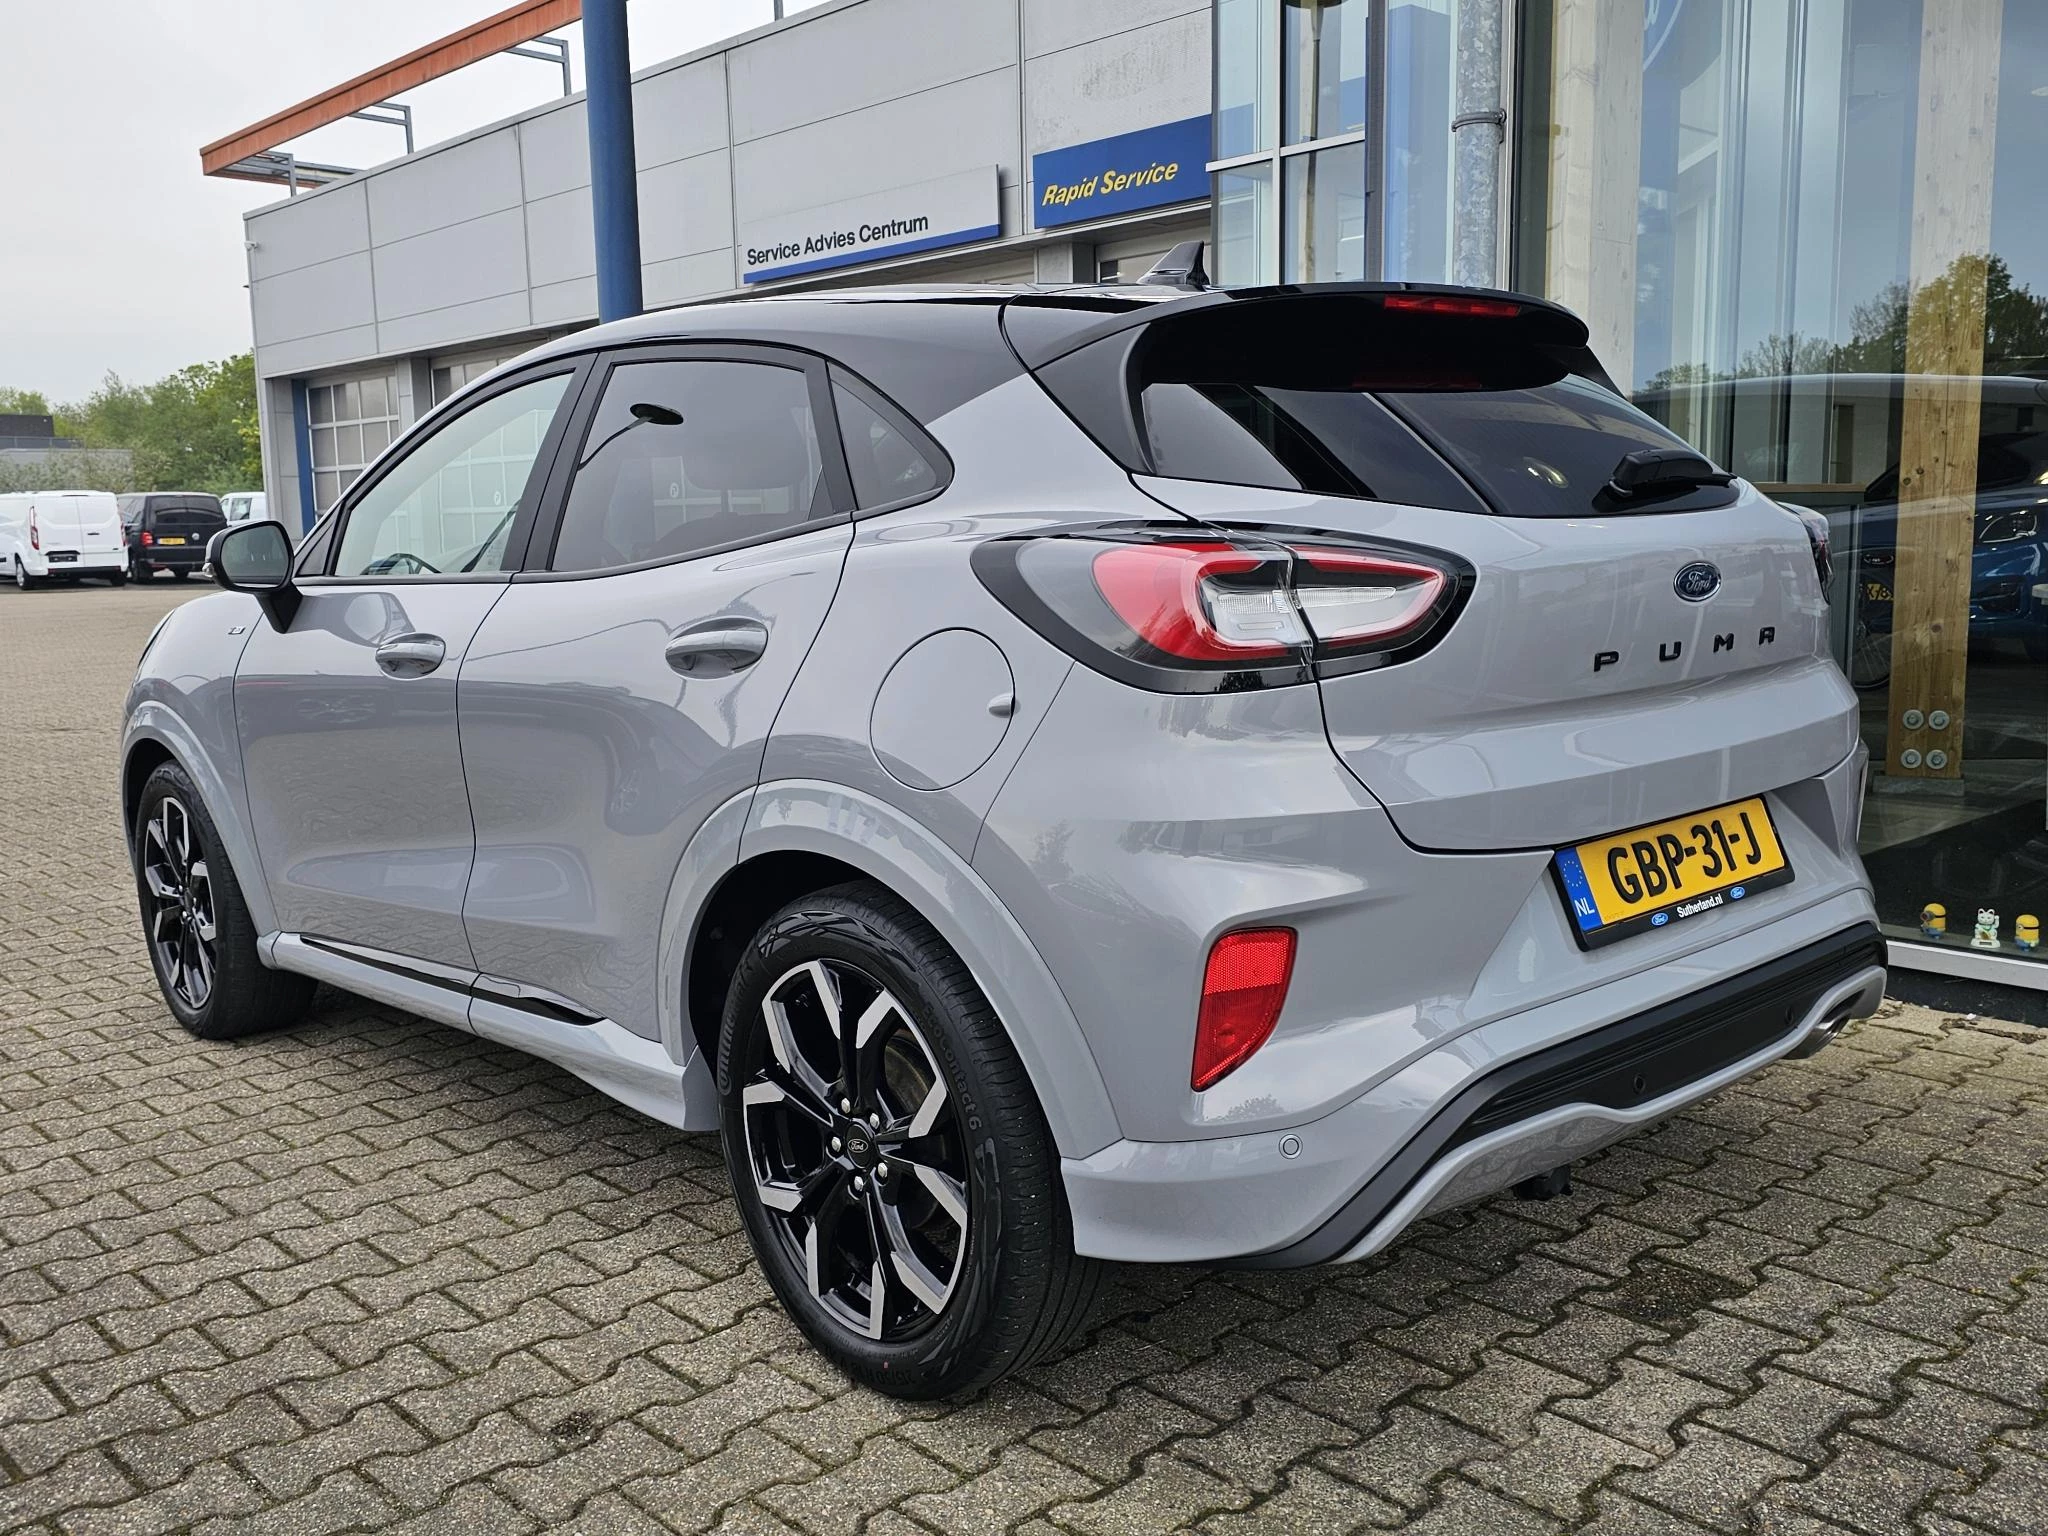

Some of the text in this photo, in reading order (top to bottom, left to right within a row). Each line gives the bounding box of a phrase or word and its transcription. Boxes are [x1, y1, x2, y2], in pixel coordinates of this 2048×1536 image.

[1041, 162, 1179, 206] Rapid Service
[747, 216, 928, 265] Service Advies Centrum
[1593, 626, 1775, 672] PUMA
[1606, 812, 1762, 904] GBP-31-J
[1574, 897, 1595, 917] NL
[1676, 893, 1724, 918] Sutherland.nl
